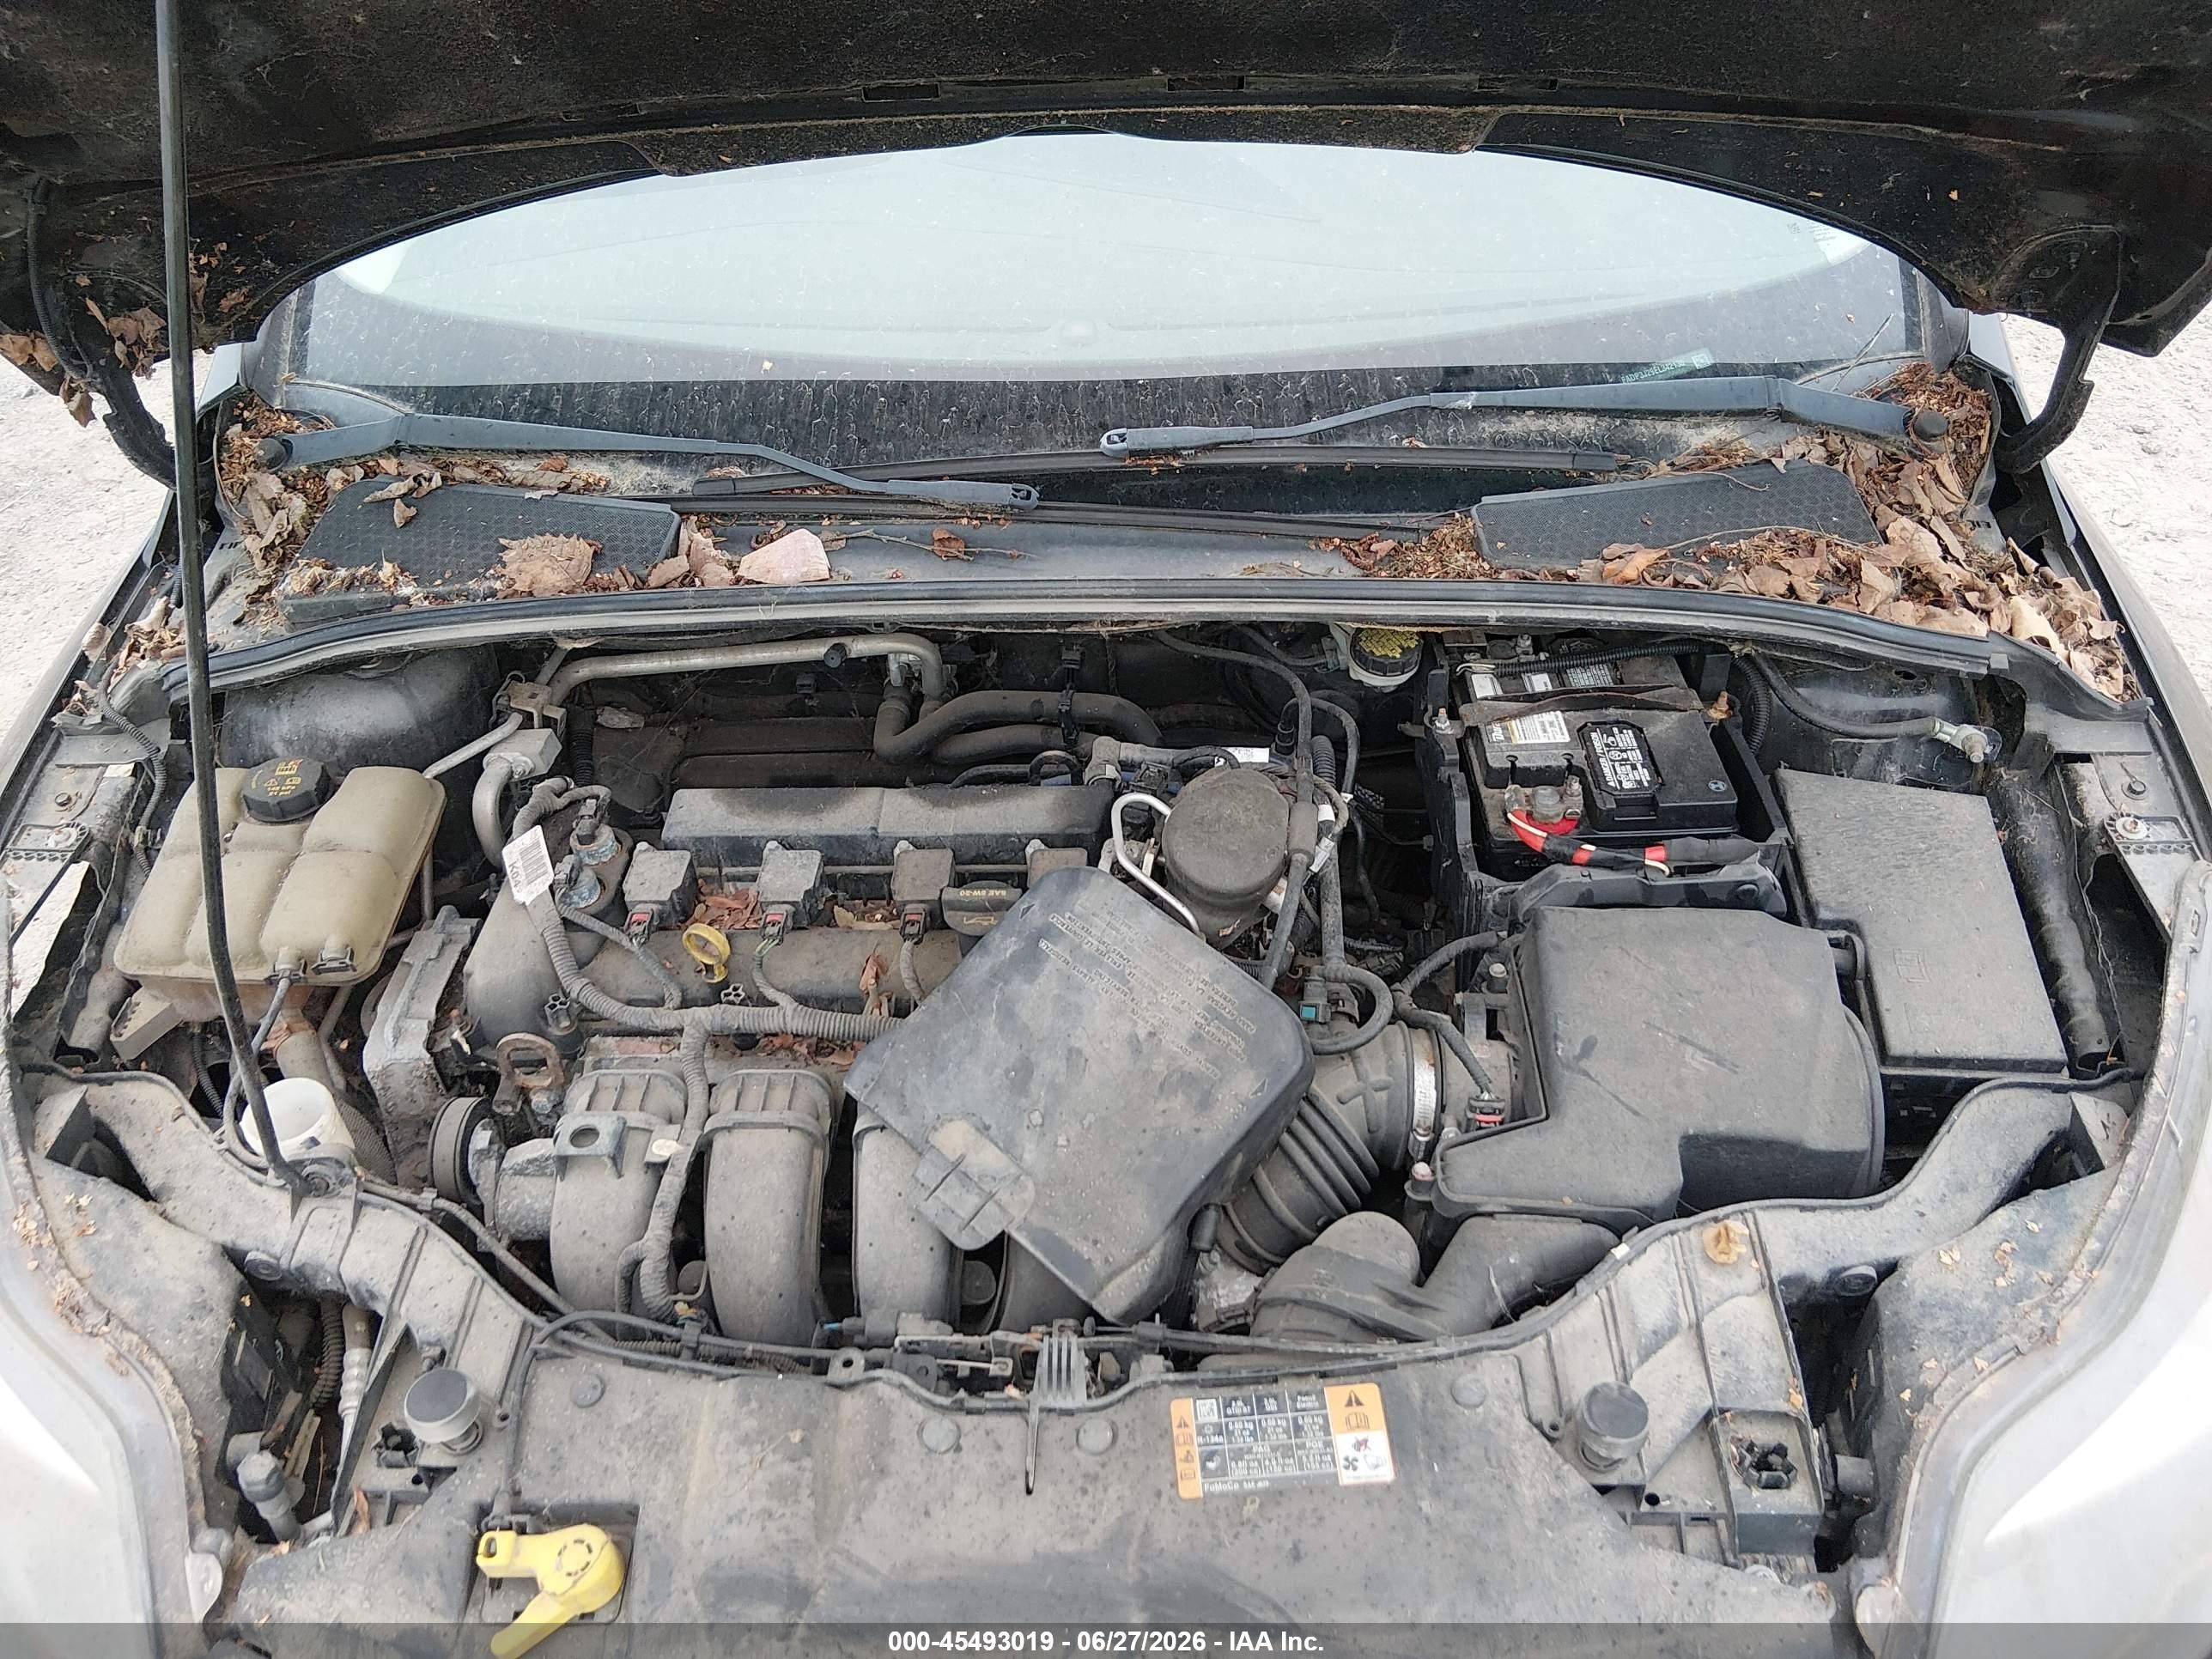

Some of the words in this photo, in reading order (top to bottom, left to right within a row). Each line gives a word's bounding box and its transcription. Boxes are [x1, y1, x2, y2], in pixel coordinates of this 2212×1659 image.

[1589, 731, 1603, 752] POISON
[1598, 757, 1613, 781] DANGER
[1203, 1479, 1239, 1493] FoMoCo
